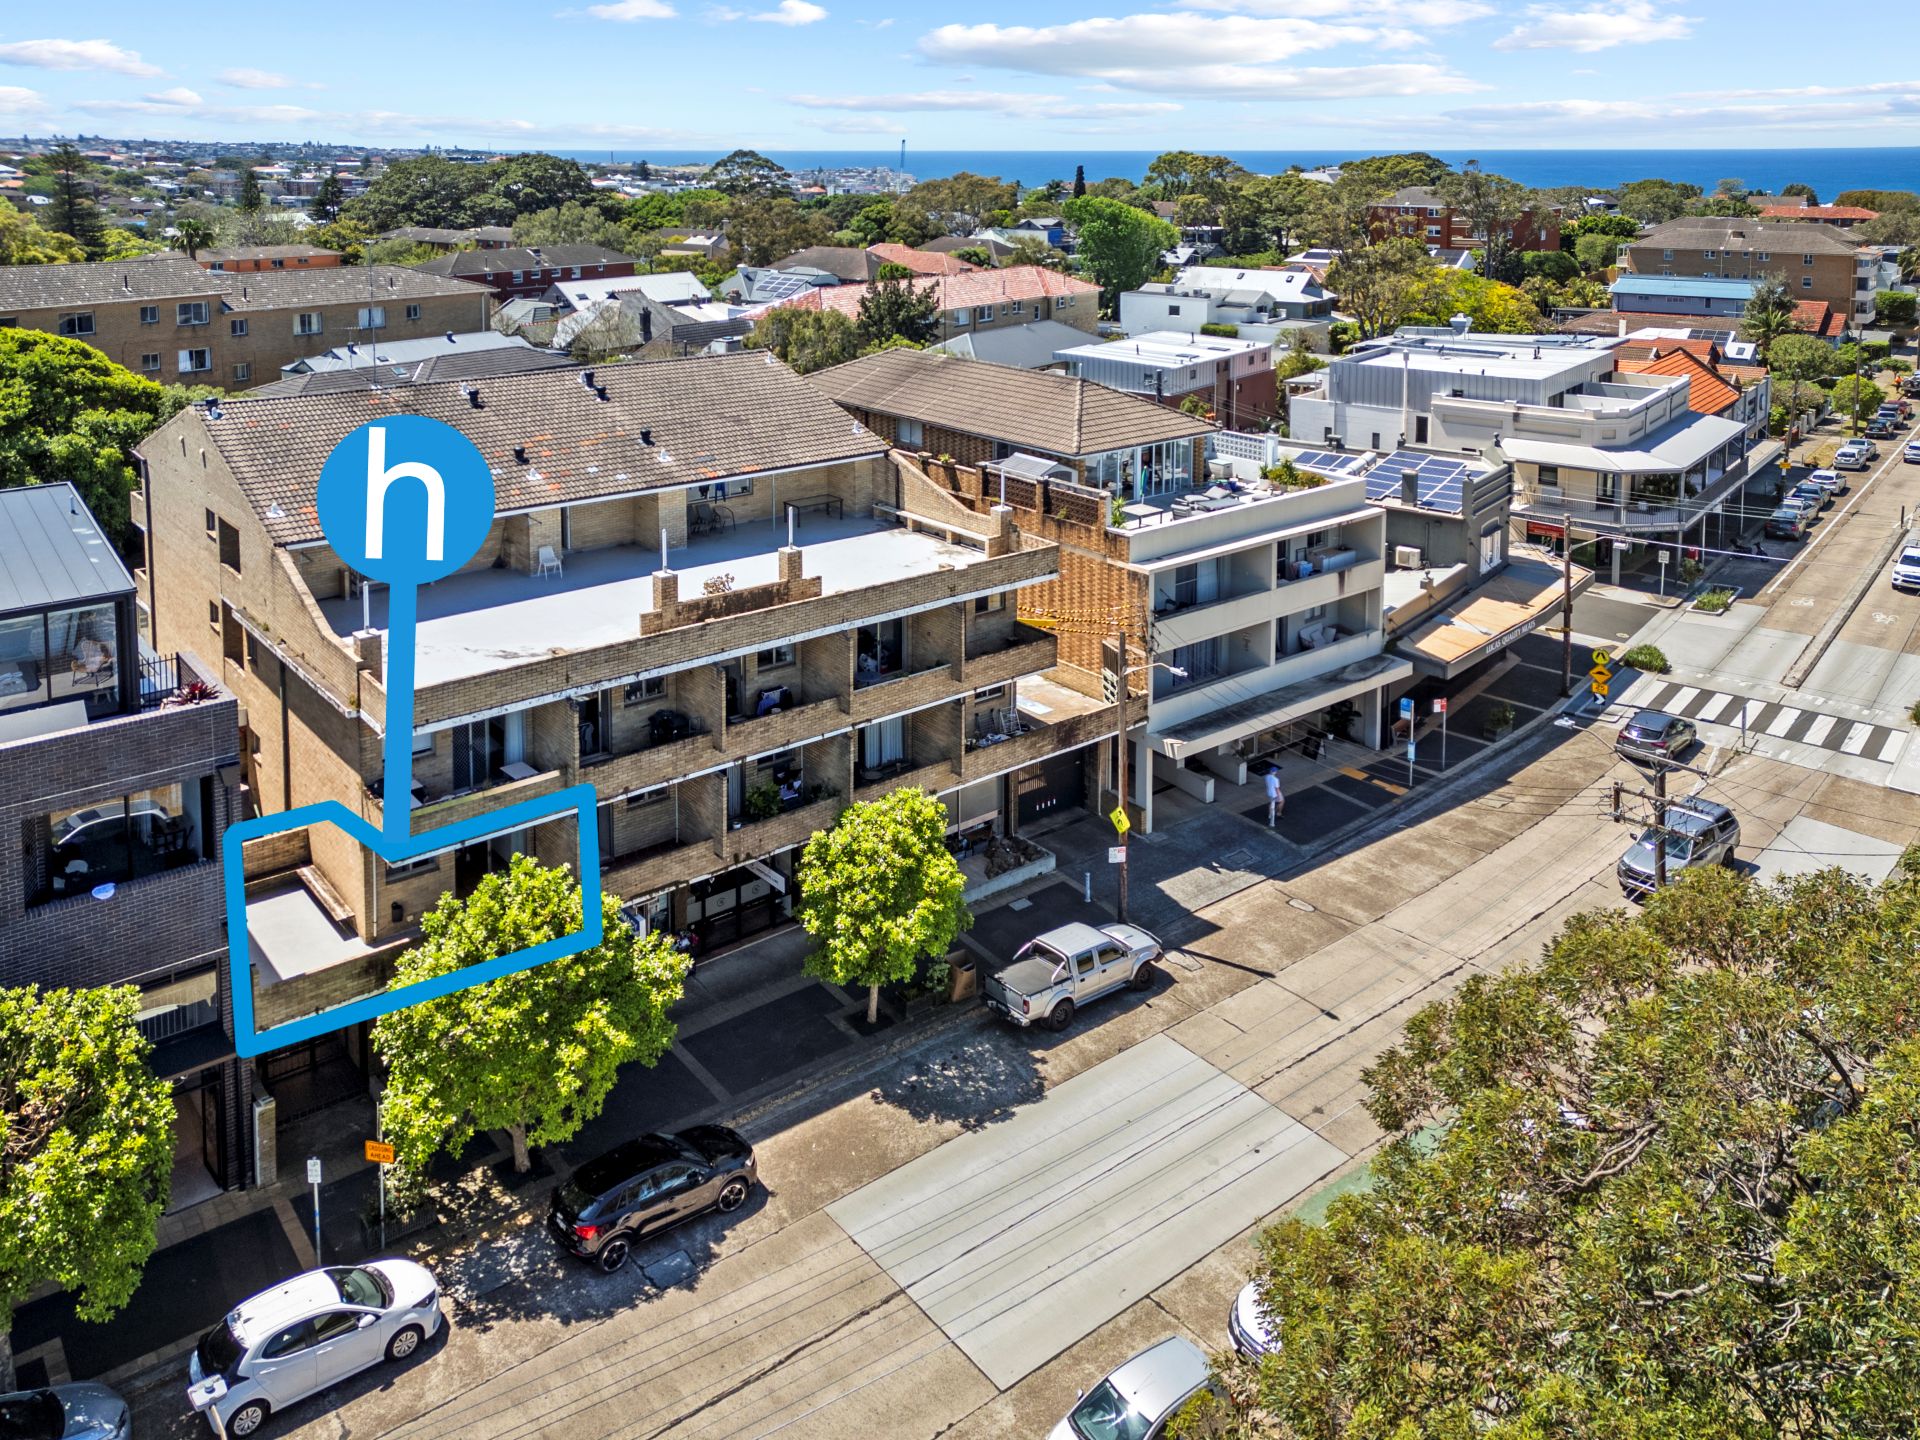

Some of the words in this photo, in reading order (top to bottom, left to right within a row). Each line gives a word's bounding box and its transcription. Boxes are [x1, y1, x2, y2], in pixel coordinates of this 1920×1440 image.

[1486, 639, 1502, 654] LUCAS
[1501, 628, 1522, 646] QUALITY
[1521, 619, 1536, 634] MEATS
[368, 1144, 393, 1153] CROSSING
[370, 1152, 391, 1160] AHEAD
